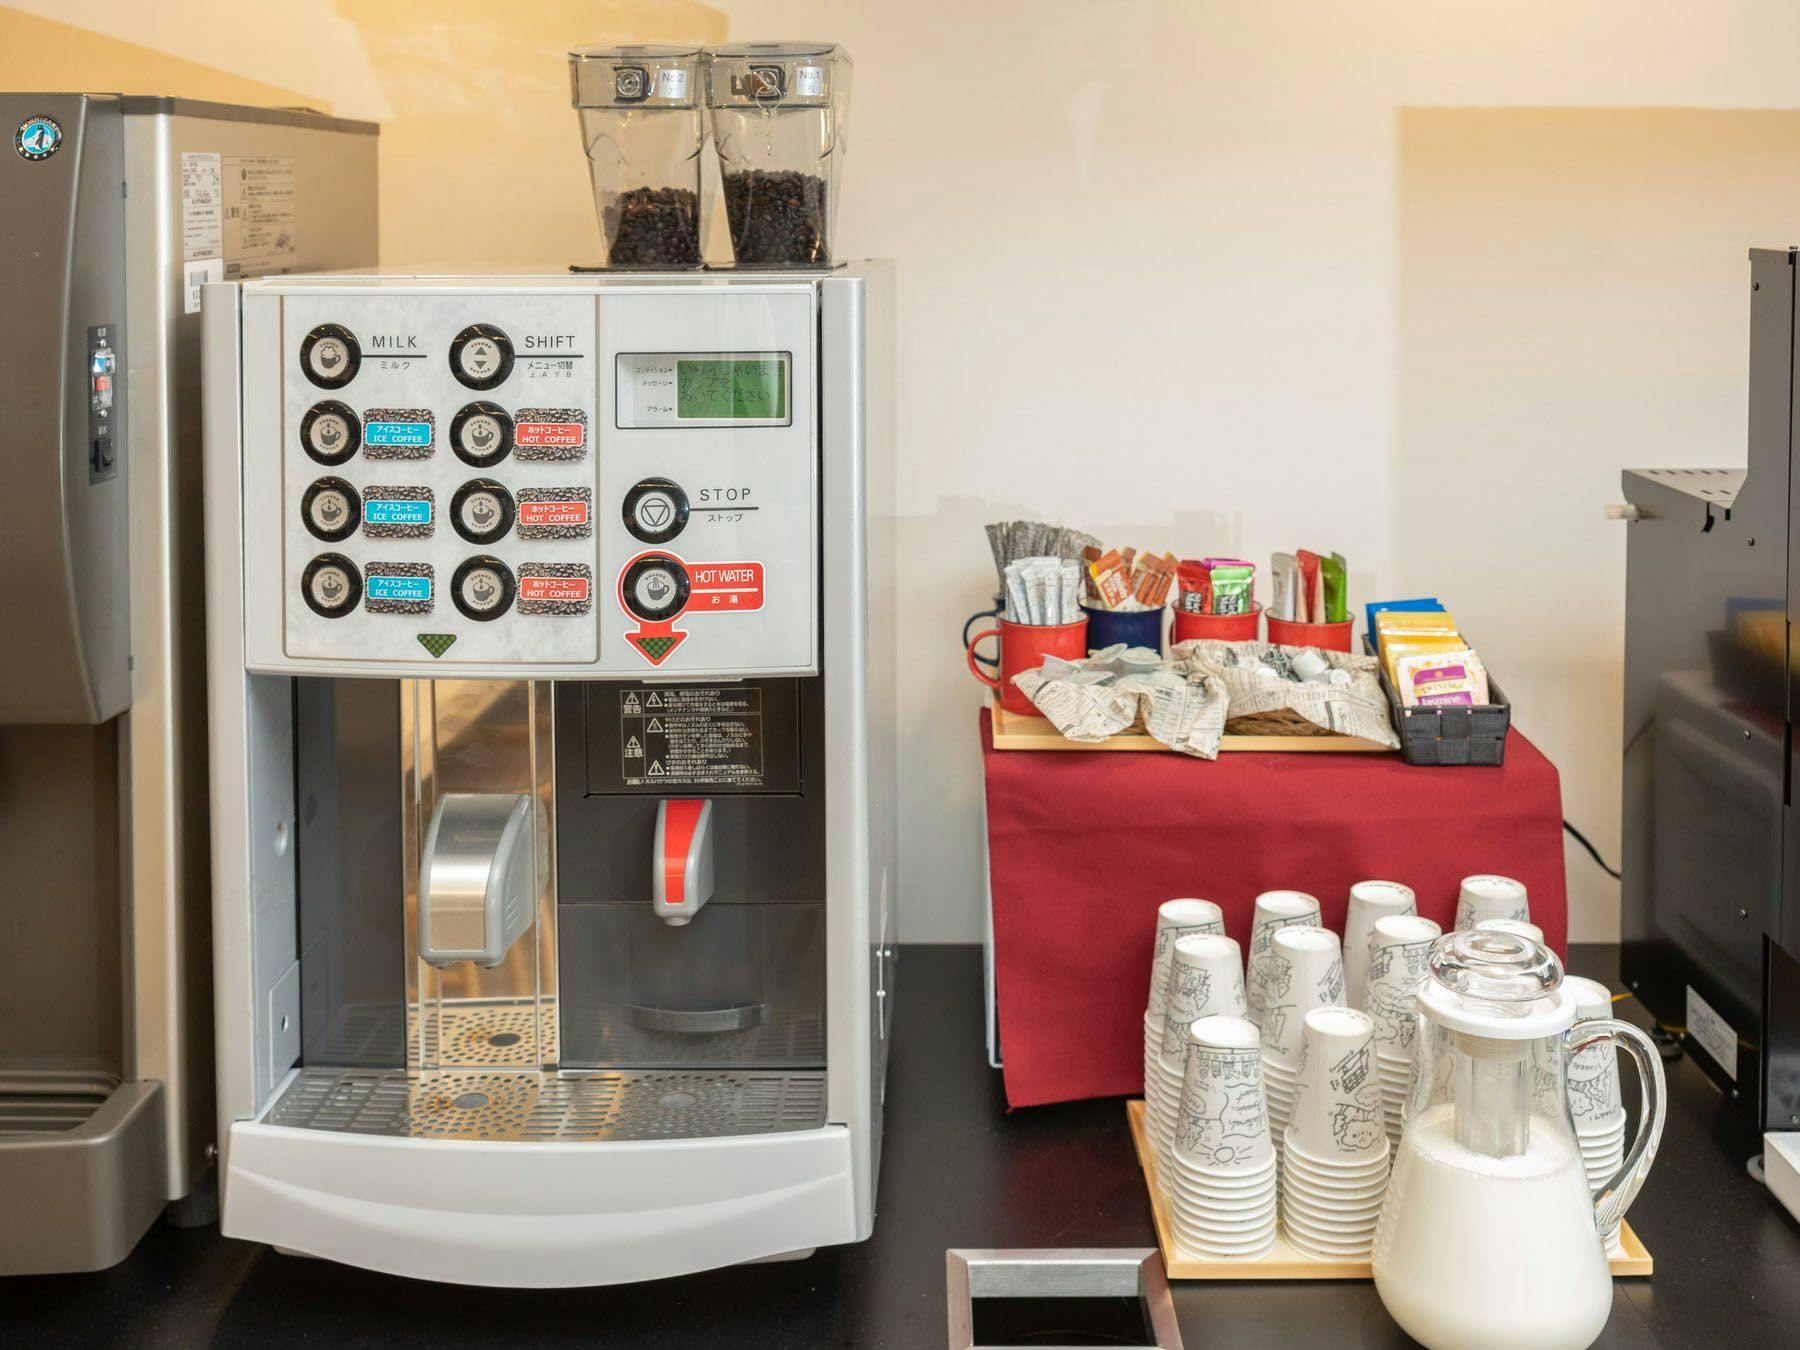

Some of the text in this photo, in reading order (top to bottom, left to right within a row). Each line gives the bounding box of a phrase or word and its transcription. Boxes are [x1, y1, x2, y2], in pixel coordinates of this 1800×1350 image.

[371, 335, 417, 348] MILK
[525, 335, 576, 349] SHIFT
[380, 361, 410, 370] ミルク
[527, 360, 574, 370] メニュー切替
[376, 425, 419, 434] アイスコーヒー
[527, 426, 570, 434] ホットコーヒー
[373, 435, 423, 443] ICE COFFEE
[522, 435, 577, 444] HOT COFFEE
[699, 488, 752, 501] STOP
[376, 503, 419, 512] アイスコーヒー
[531, 505, 574, 513] ホットコーヒー
[373, 513, 423, 521] ICE COFFEE
[526, 514, 581, 522] HOT COFFEE
[707, 513, 743, 523] ストップ
[695, 570, 754, 583] HOT WATER
[377, 580, 419, 588] アイスコーヒー
[531, 580, 575, 588] ホットコーヒー
[393, 589, 423, 597] COFFEE
[526, 589, 581, 598] HOT COFFEE
[623, 705, 642, 714] 警告
[624, 748, 643, 758] 注意
